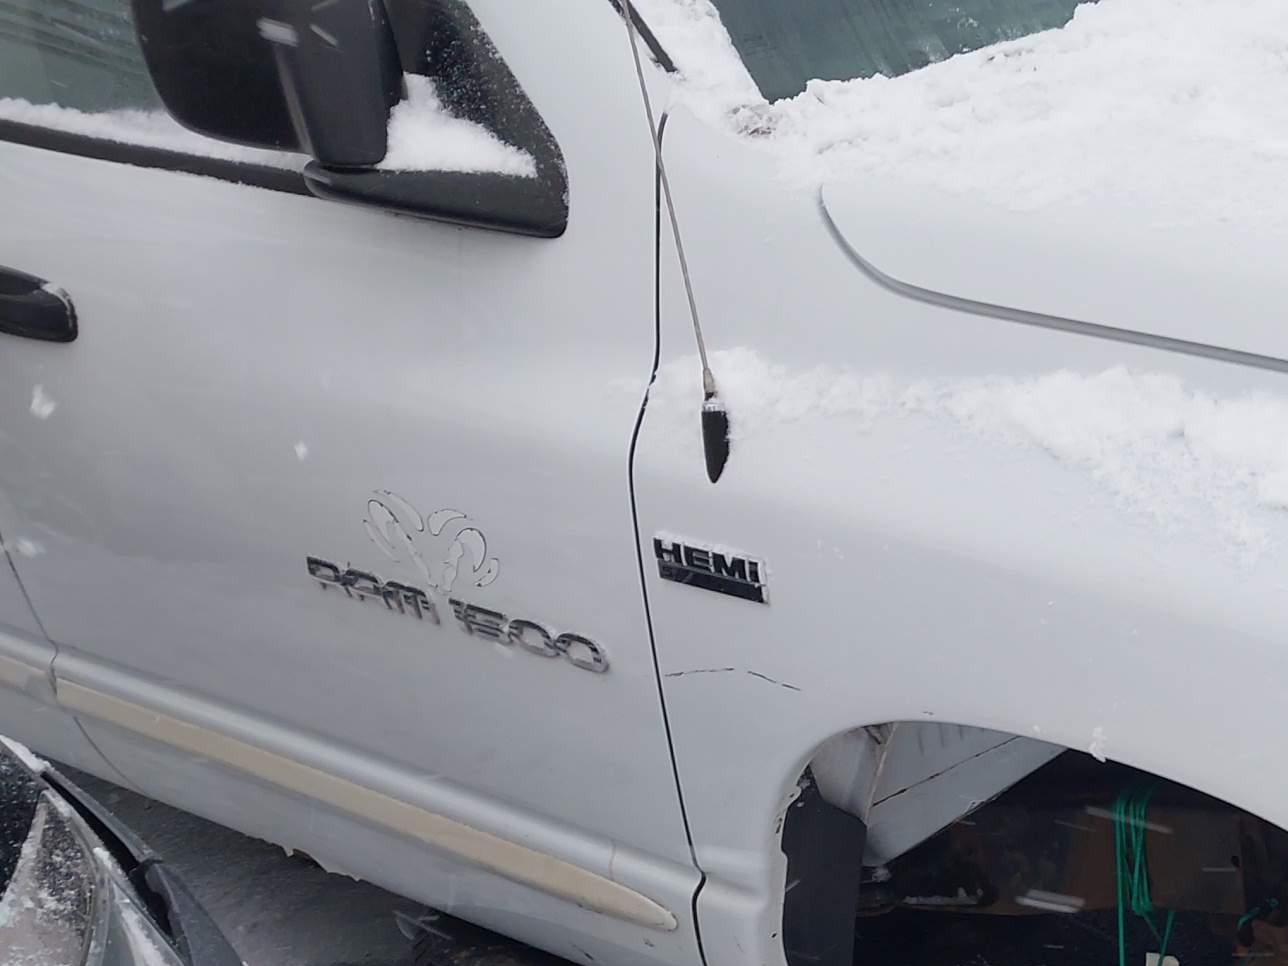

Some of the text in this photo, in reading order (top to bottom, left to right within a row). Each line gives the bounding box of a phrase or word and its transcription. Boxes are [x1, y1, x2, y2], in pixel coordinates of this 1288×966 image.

[653, 536, 761, 583] HEMI
[306, 556, 611, 673] RAM 1500
